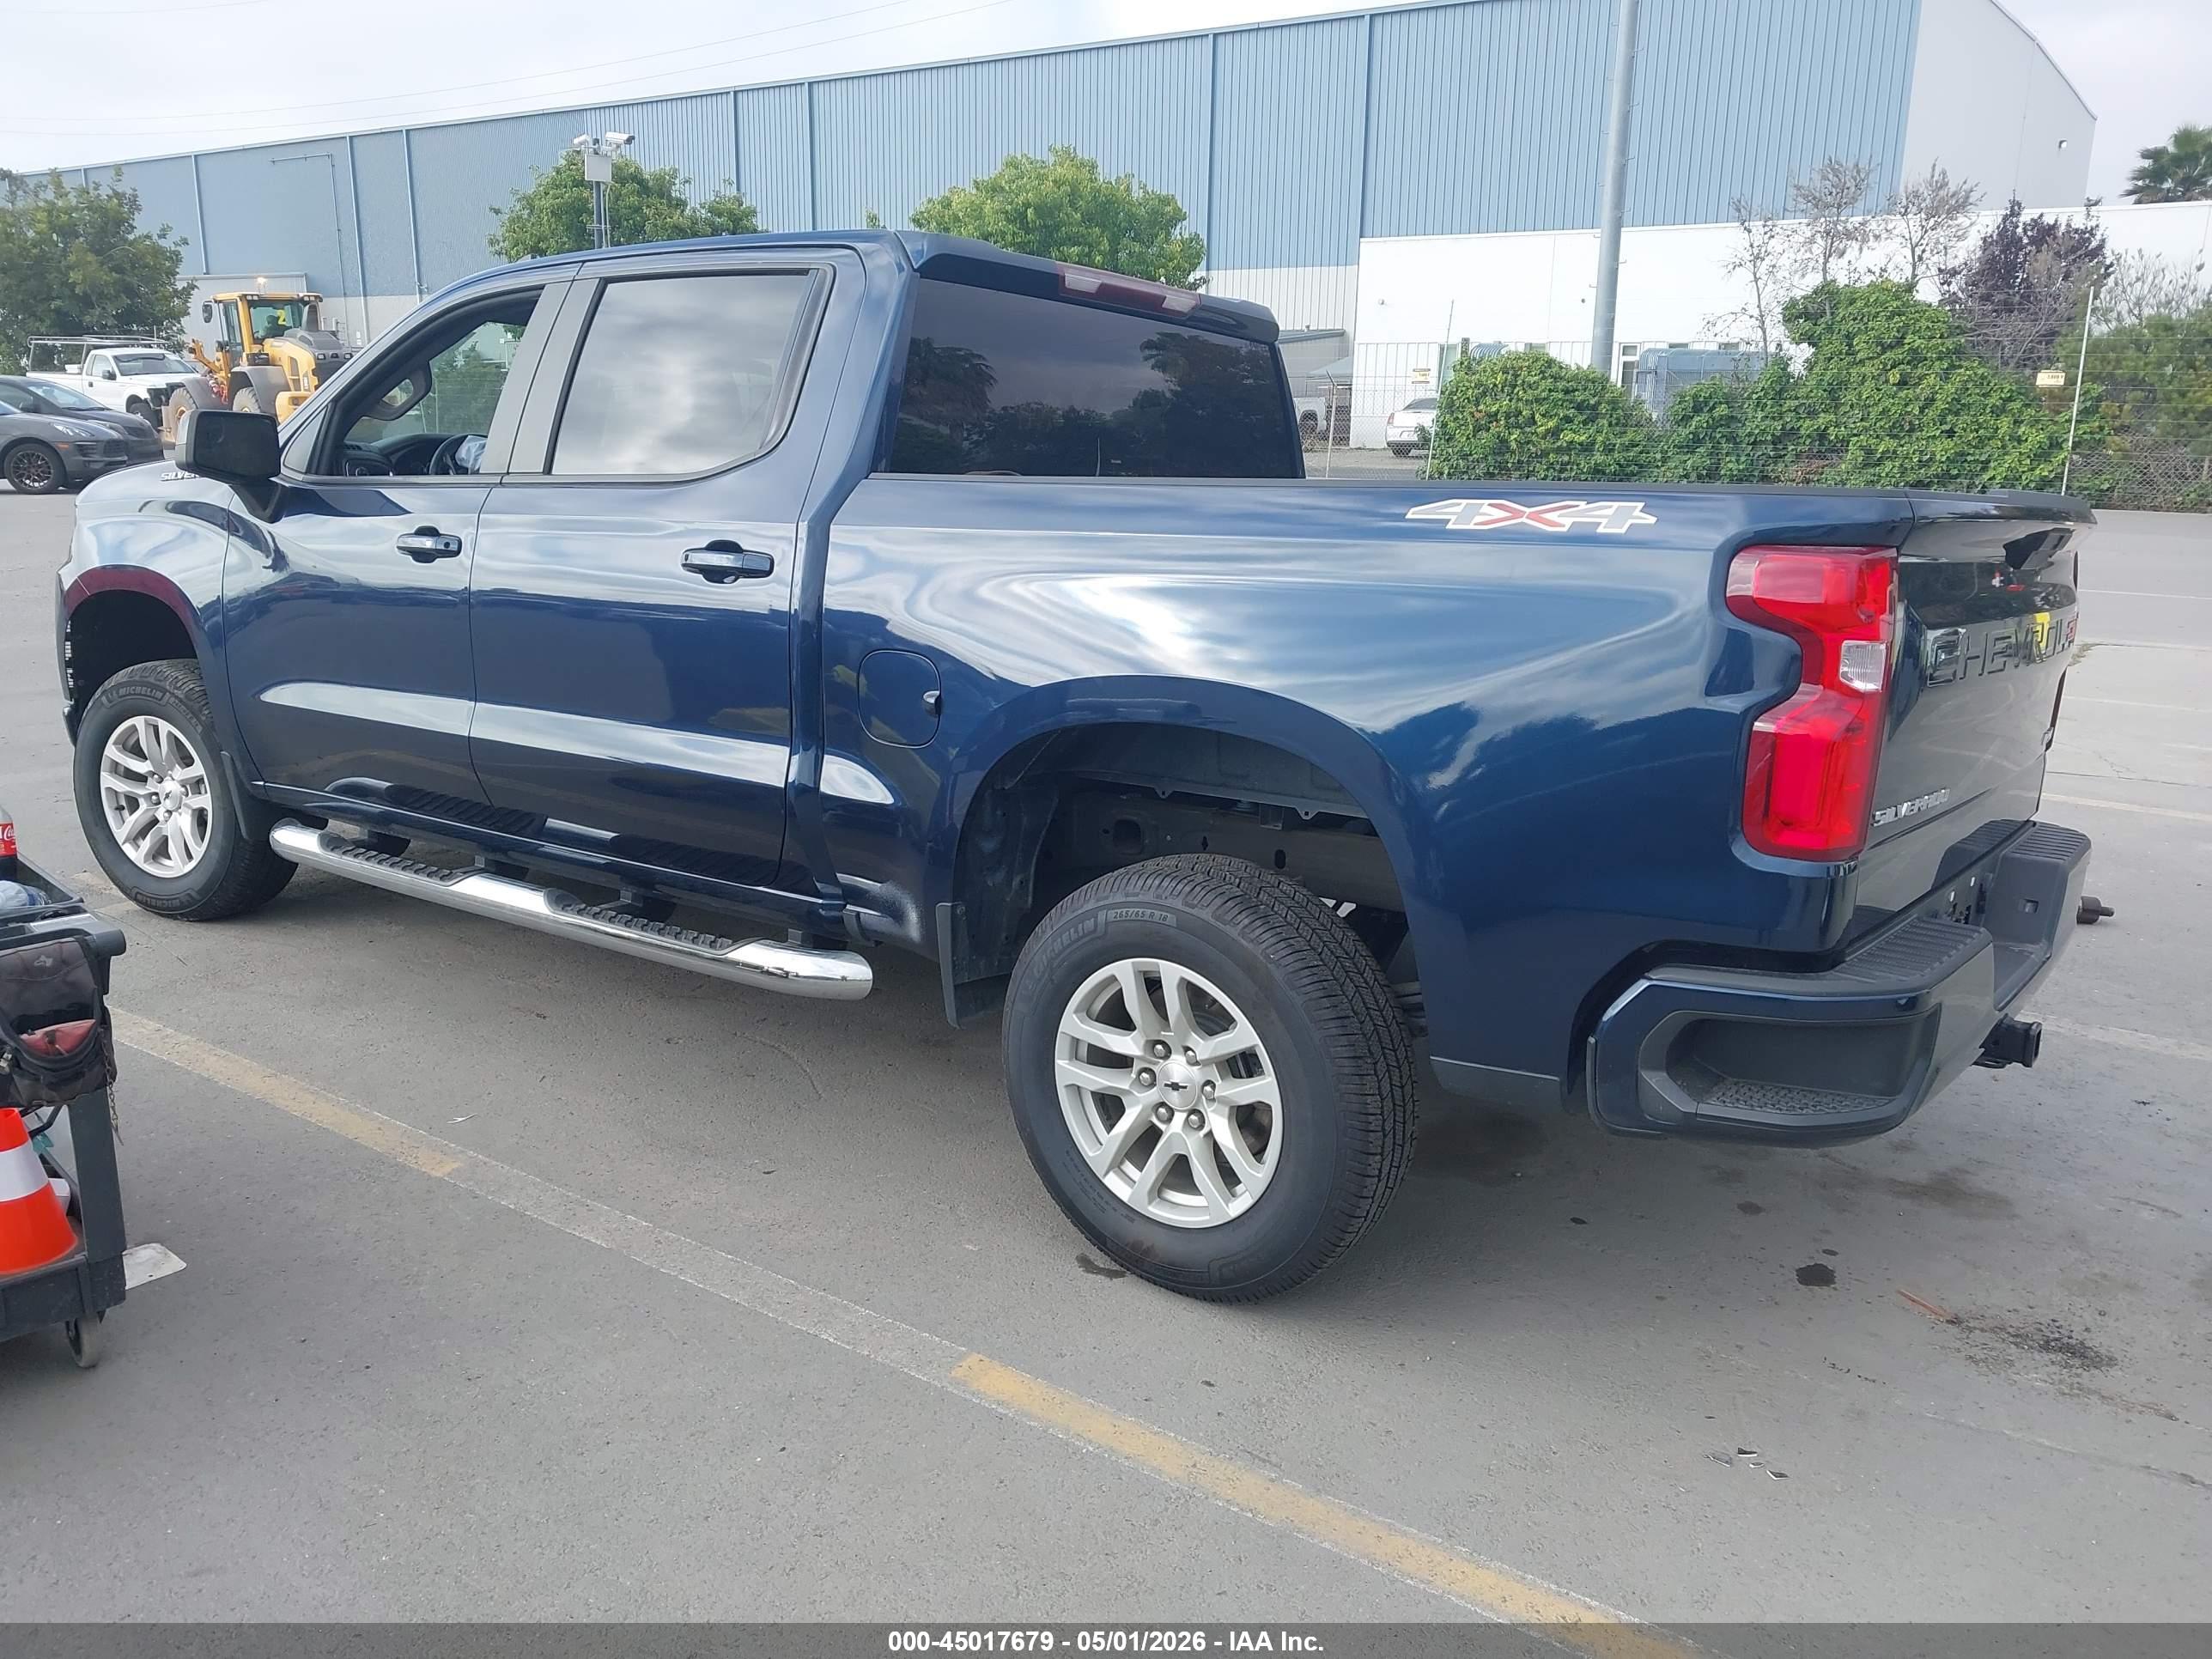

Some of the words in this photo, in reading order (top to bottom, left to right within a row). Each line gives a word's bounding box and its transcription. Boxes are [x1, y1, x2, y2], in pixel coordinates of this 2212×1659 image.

[118, 686, 164, 700] MICHELIN
[1872, 787, 1950, 827] SILVERADO
[1113, 910, 1146, 920] 265/65
[1148, 911, 1156, 921] R
[1158, 914, 1169, 922] 18
